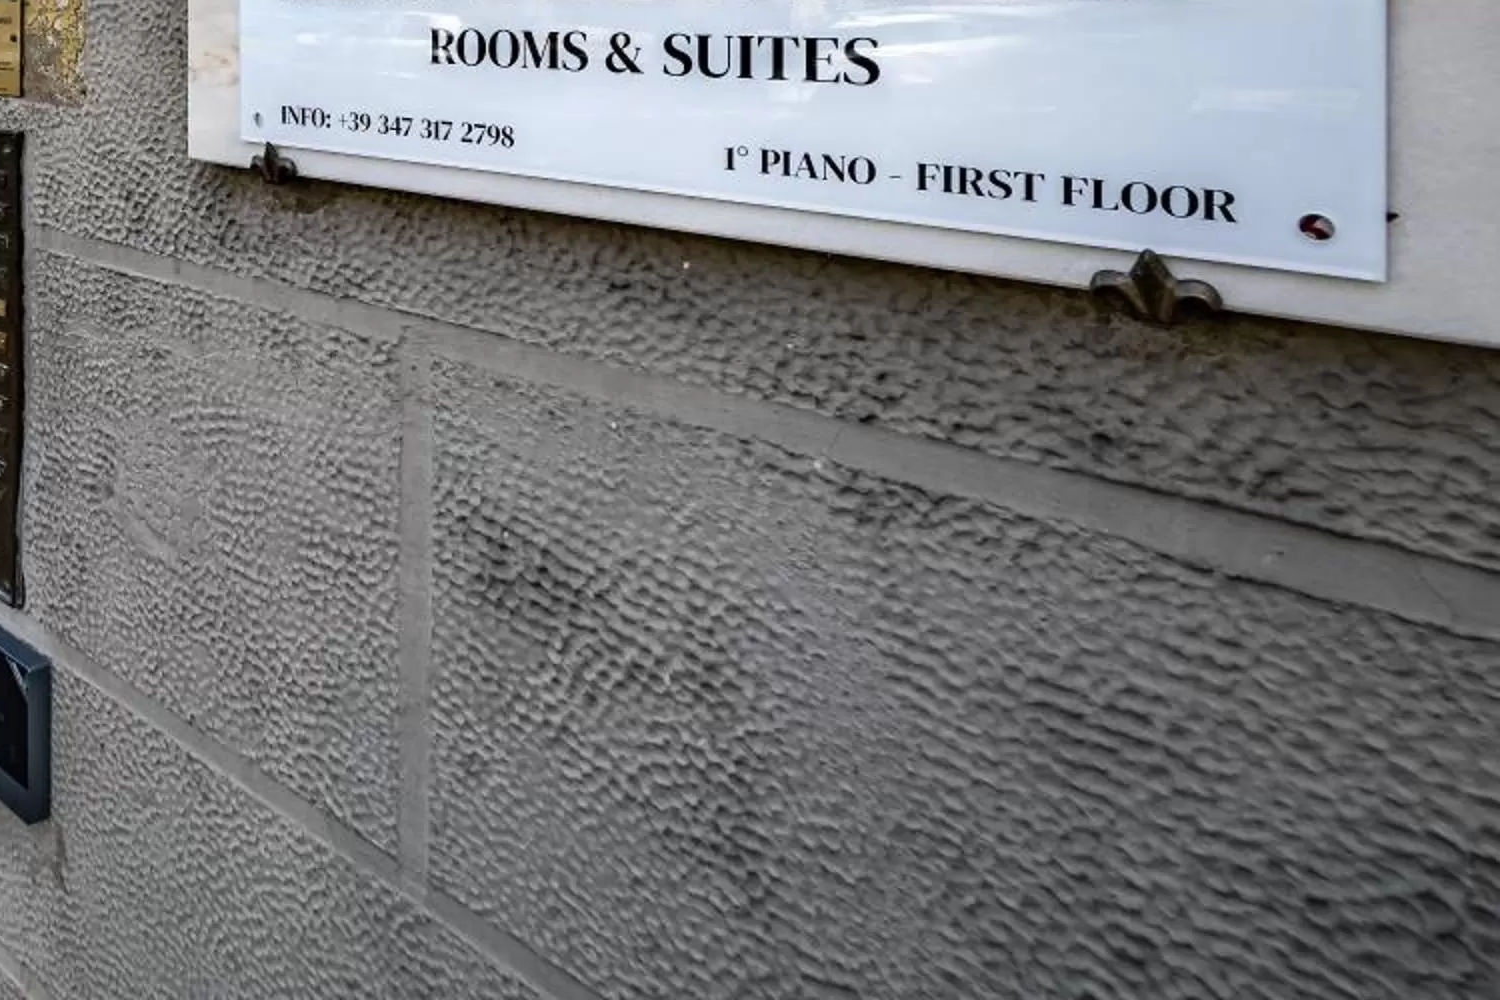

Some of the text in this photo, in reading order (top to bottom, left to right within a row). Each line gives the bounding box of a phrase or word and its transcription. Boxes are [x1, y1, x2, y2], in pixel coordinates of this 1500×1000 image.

[430, 26, 881, 86] ROOMS & SUITES
[281, 105, 516, 149] INFO: +39 347 317 2798
[723, 144, 750, 172] 1°
[760, 149, 877, 185] PIANO
[916, 163, 1045, 203] FIRST
[1060, 175, 1238, 224] FLOOR
